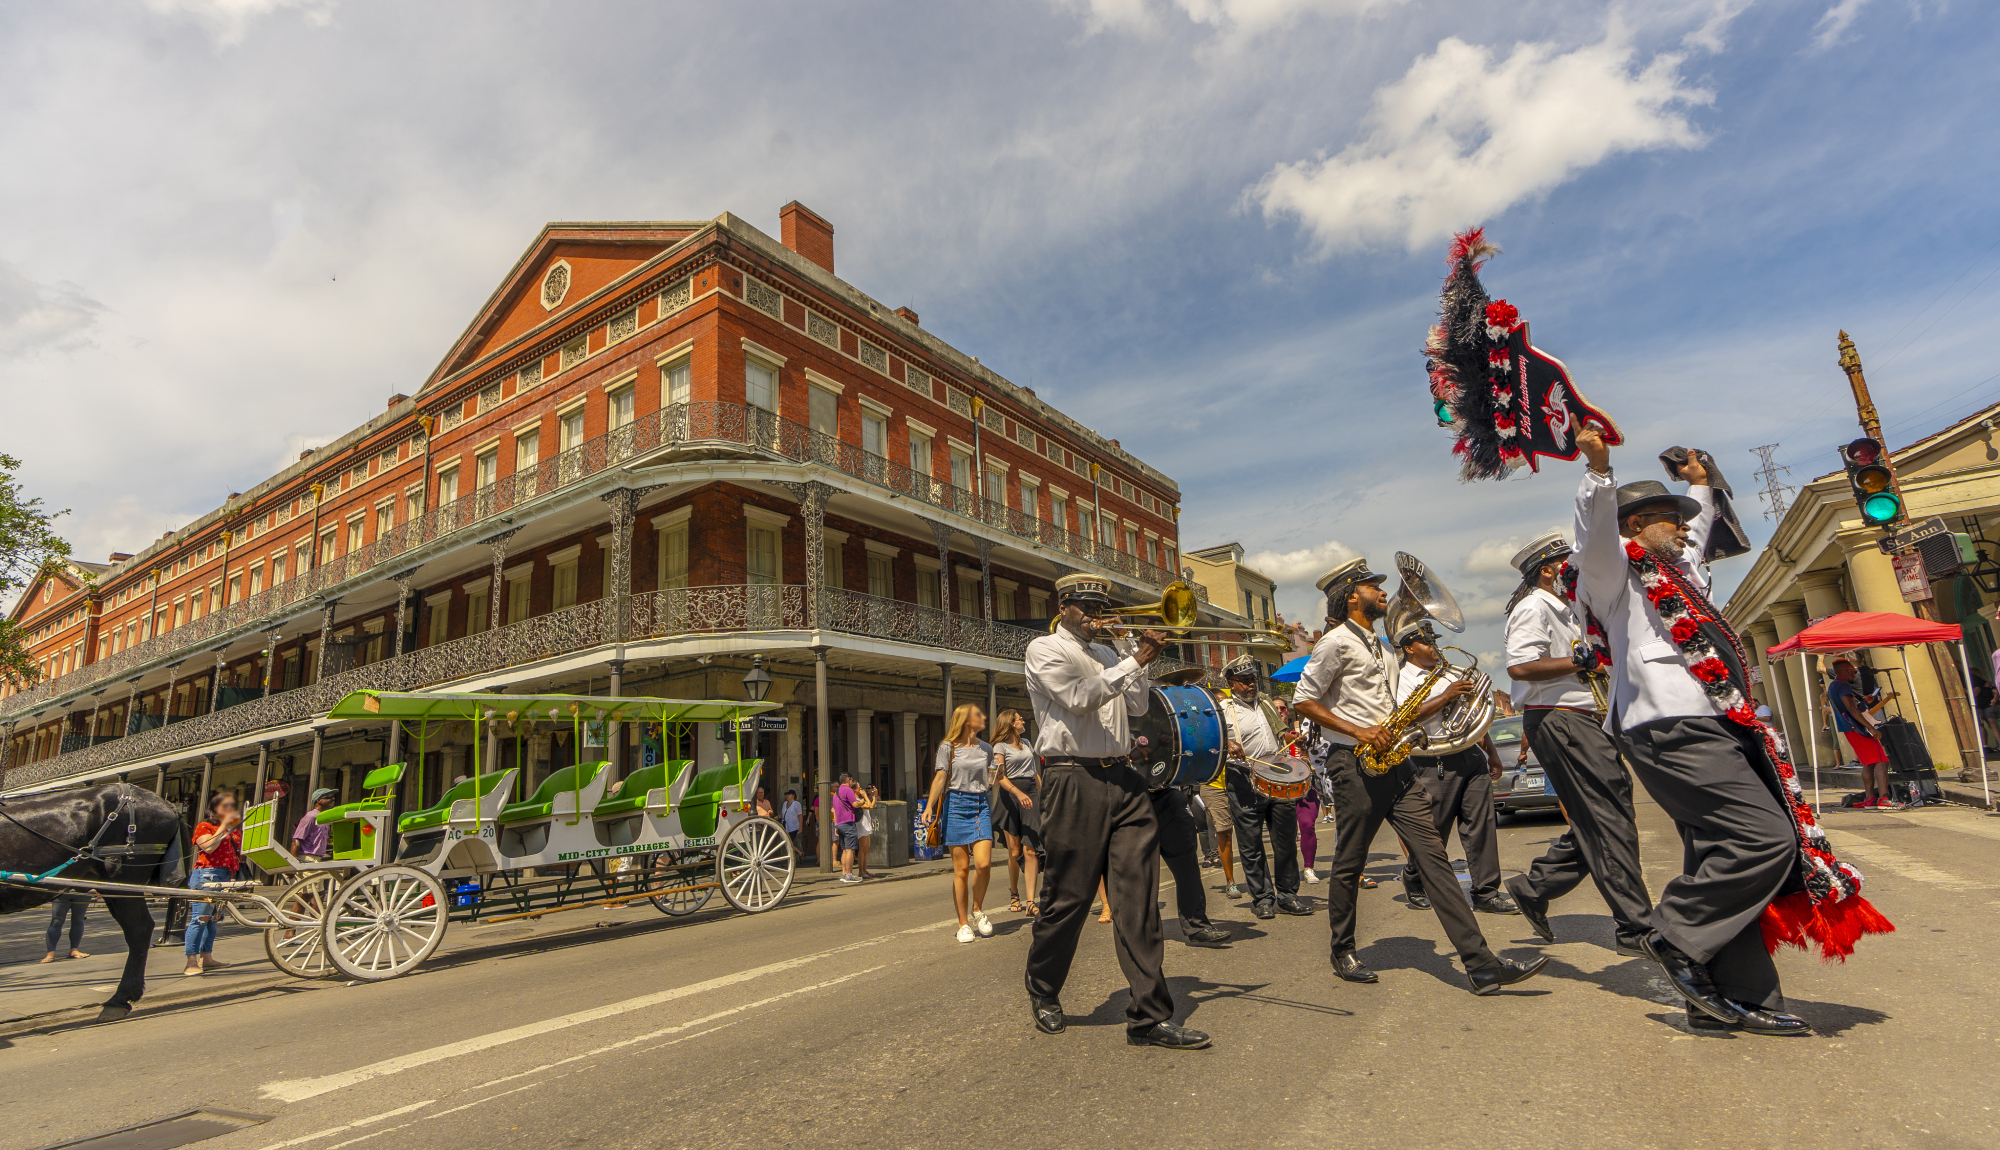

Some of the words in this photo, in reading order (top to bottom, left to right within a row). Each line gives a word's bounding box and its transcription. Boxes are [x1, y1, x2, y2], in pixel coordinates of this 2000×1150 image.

[1518, 354, 1531, 415] Anniversary
[1886, 537, 1905, 549] St.
[1910, 525, 1938, 541] Ann
[1901, 566, 1917, 576] ANY
[1903, 573, 1920, 582] TIME
[761, 720, 786, 729] Decatur
[448, 830, 462, 841] AC
[483, 828, 494, 838] 20
[557, 847, 611, 861] MID-CITY
[616, 841, 670, 855] CARRIAGES
